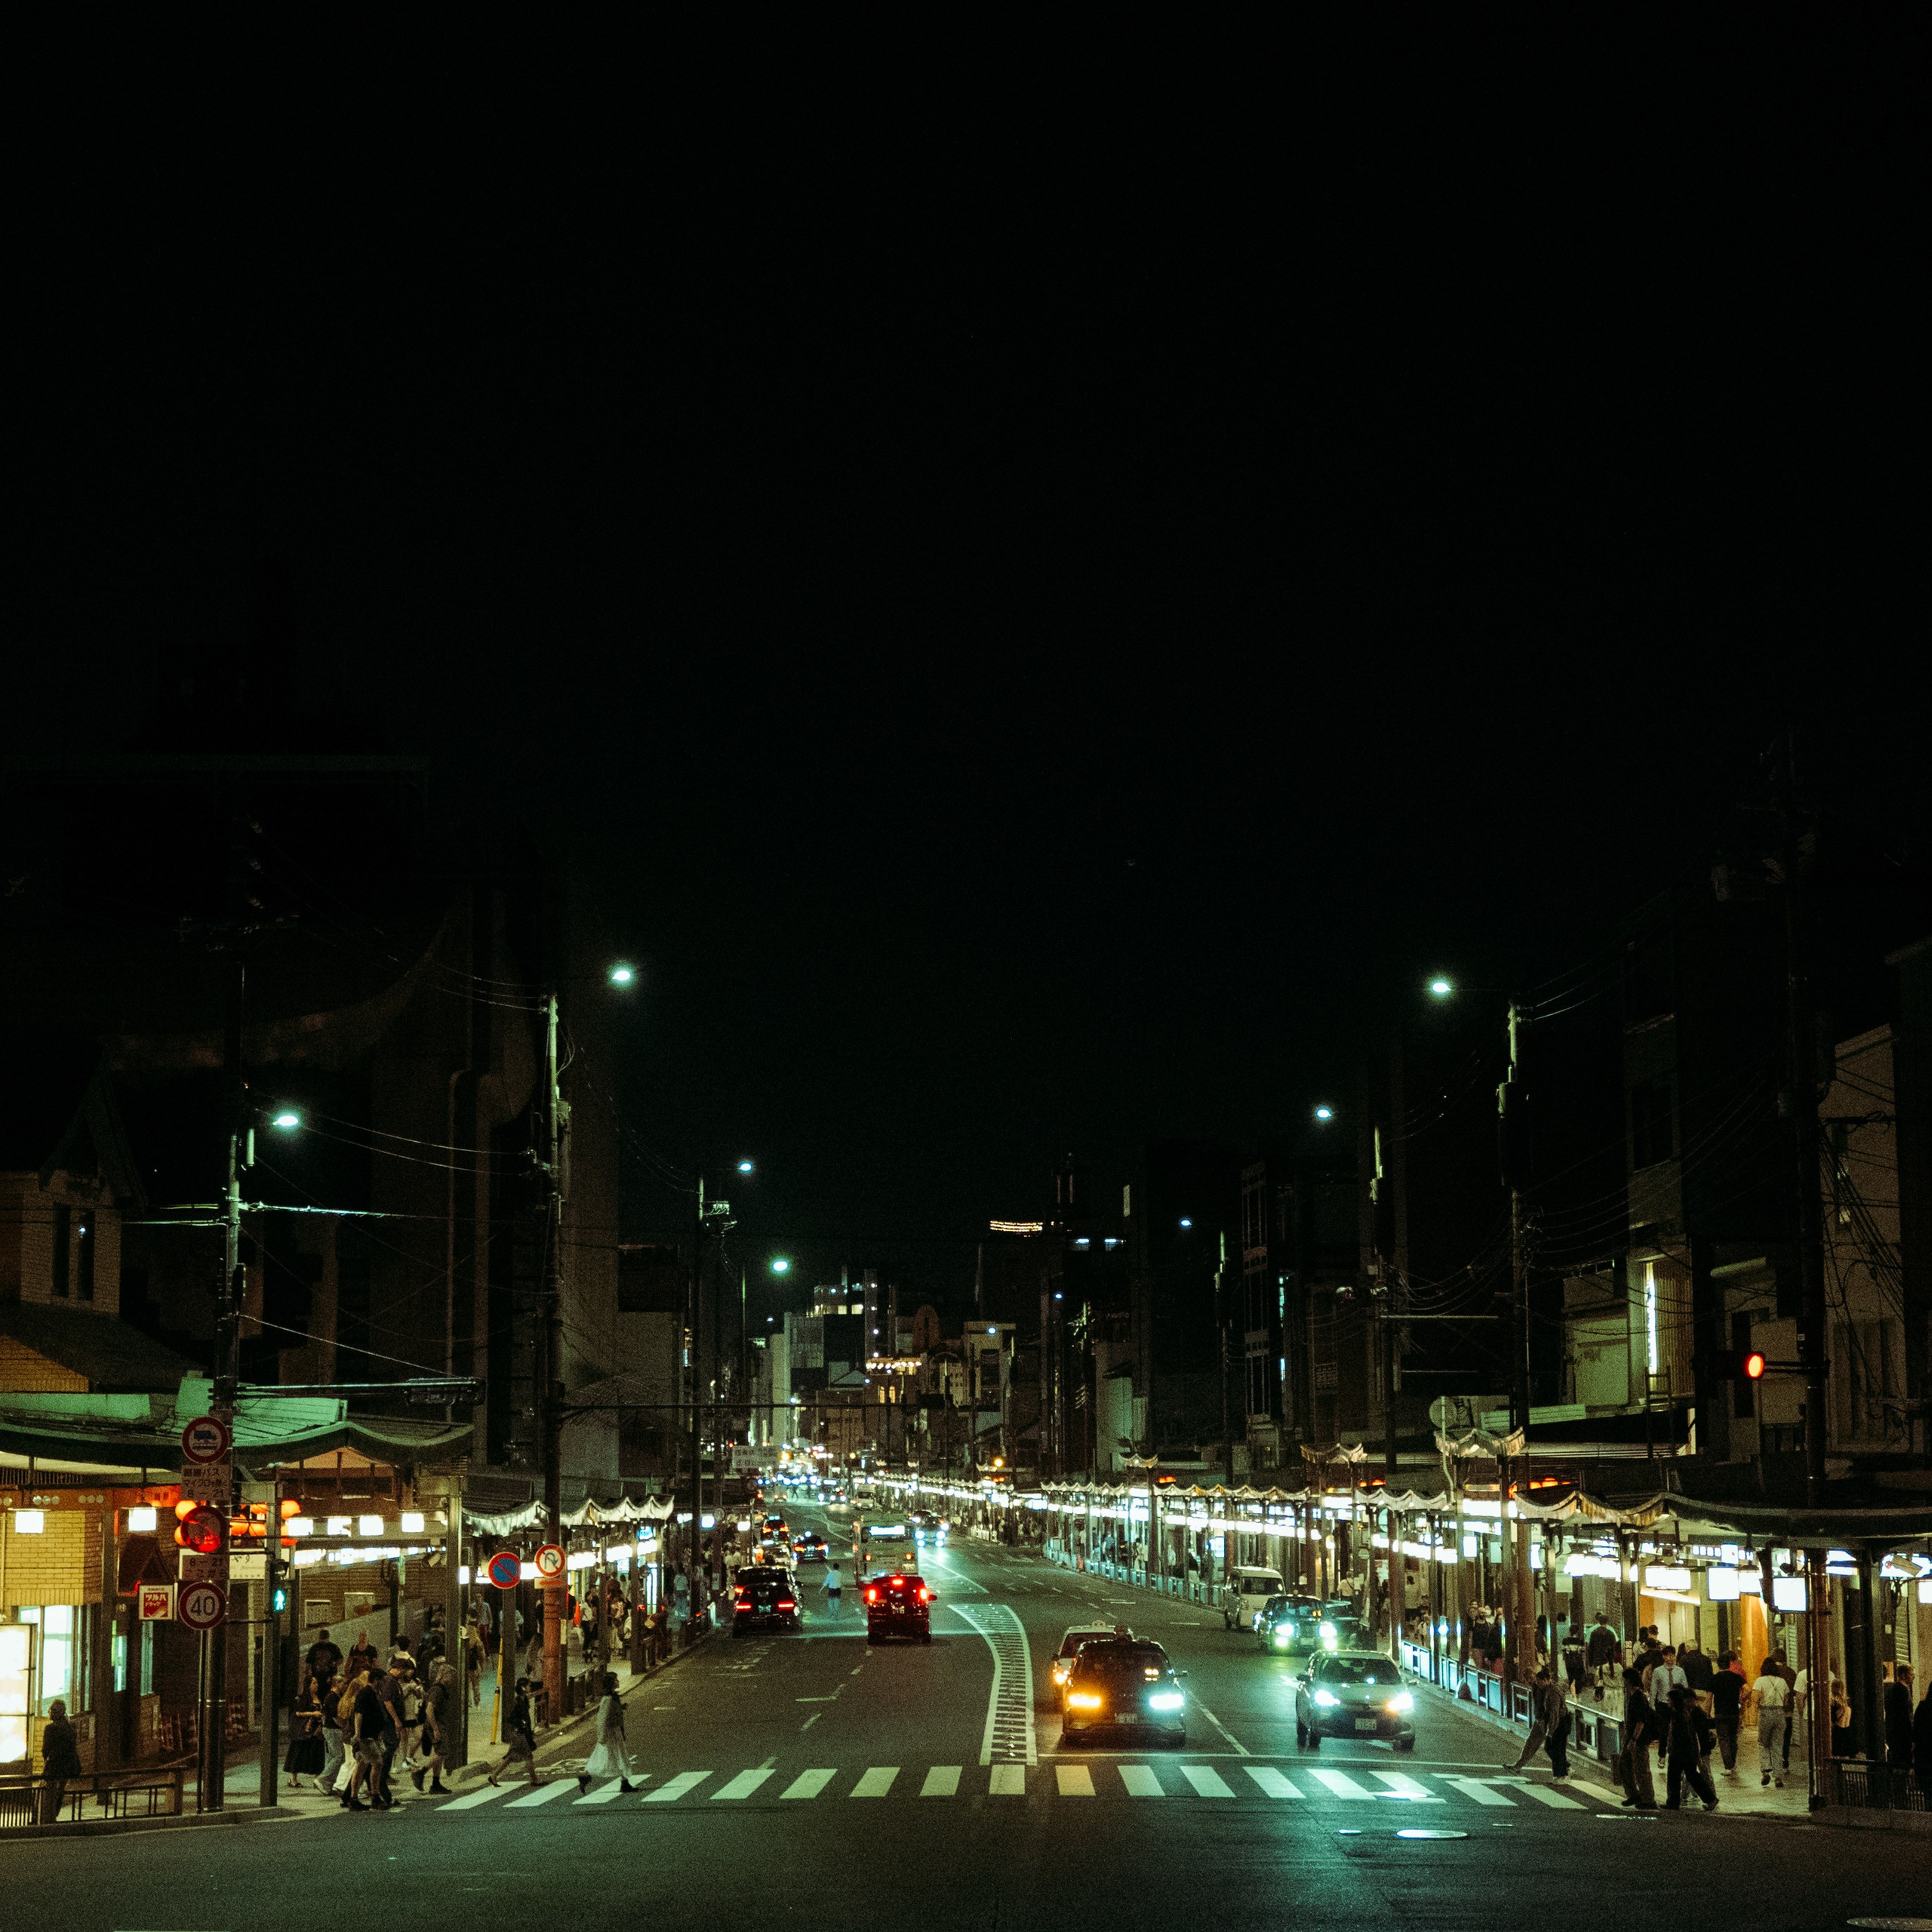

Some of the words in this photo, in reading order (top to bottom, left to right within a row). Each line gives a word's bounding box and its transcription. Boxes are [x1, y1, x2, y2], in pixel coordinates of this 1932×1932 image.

[144, 1593, 167, 1601] ツルハ
[190, 1595, 216, 1616] 40
